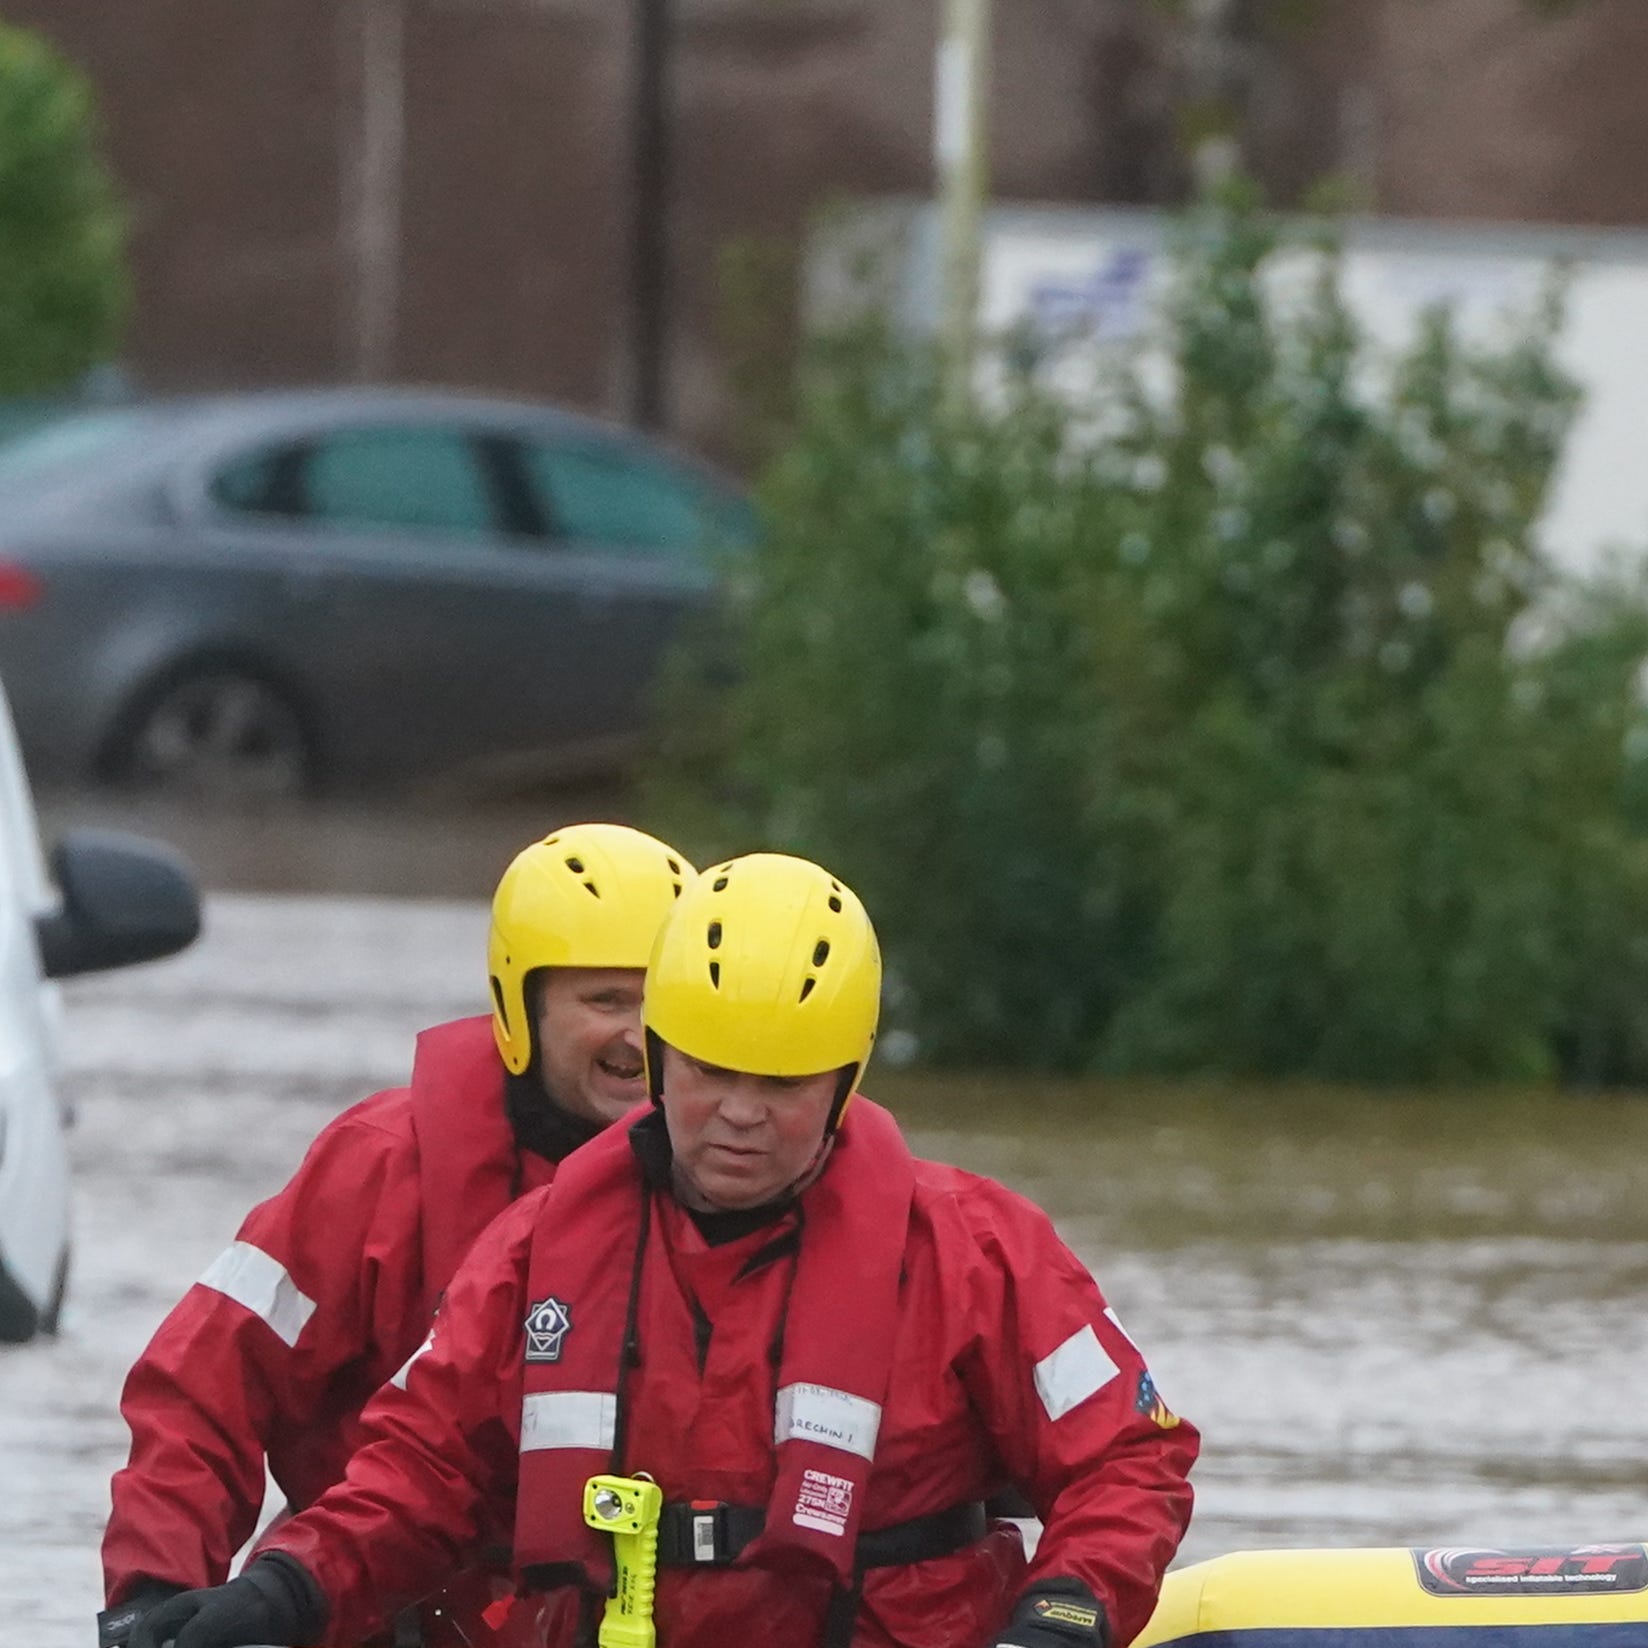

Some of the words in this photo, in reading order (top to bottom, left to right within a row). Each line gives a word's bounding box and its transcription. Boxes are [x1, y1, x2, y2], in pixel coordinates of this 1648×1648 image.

[803, 1469, 855, 1492] CREWFIT
[1465, 1554, 1642, 1576] SIT
[1465, 1575, 1519, 1584] specialised
[1520, 1574, 1564, 1583] inflatable
[1564, 1573, 1617, 1583] technology
